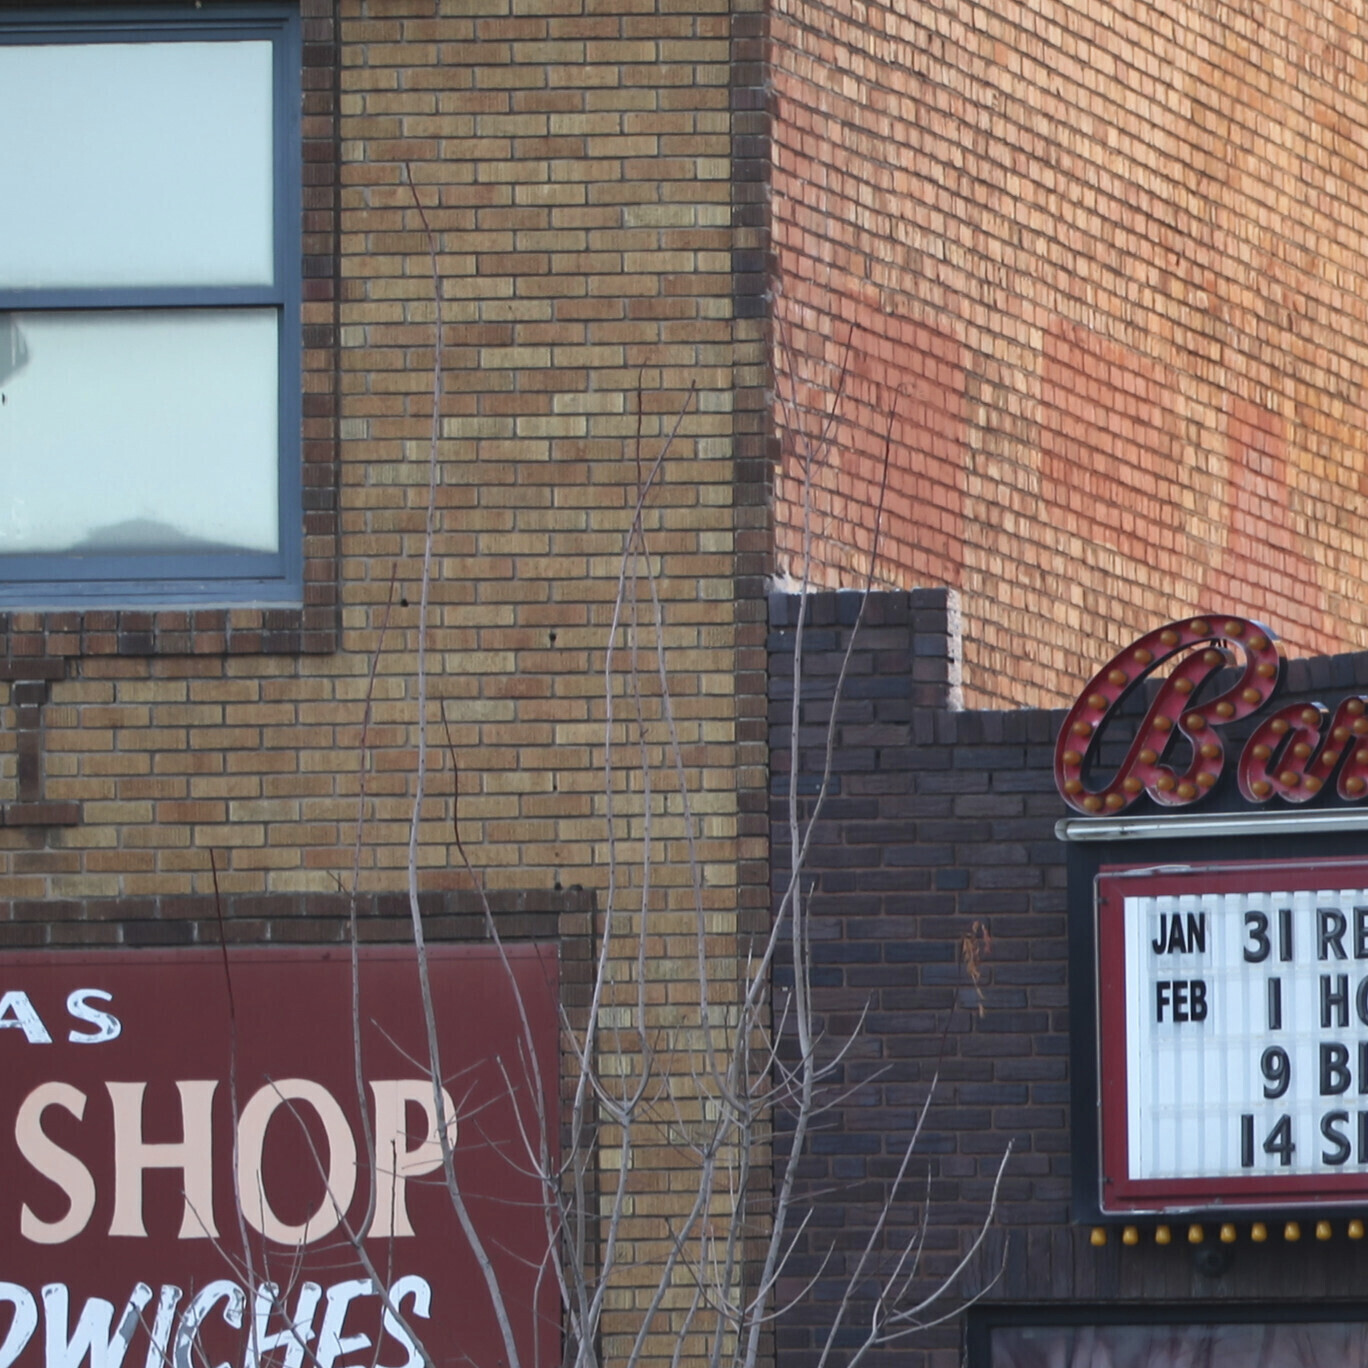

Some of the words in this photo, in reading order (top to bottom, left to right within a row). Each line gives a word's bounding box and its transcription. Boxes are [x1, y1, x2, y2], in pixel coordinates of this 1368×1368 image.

[1152, 911, 1206, 955] JAN
[1243, 908, 1293, 963] 31
[1155, 979, 1208, 1023] FEB
[1260, 1045, 1291, 1100] 9
[14, 1078, 458, 1246] SHOP
[1240, 1113, 1296, 1168] 14
